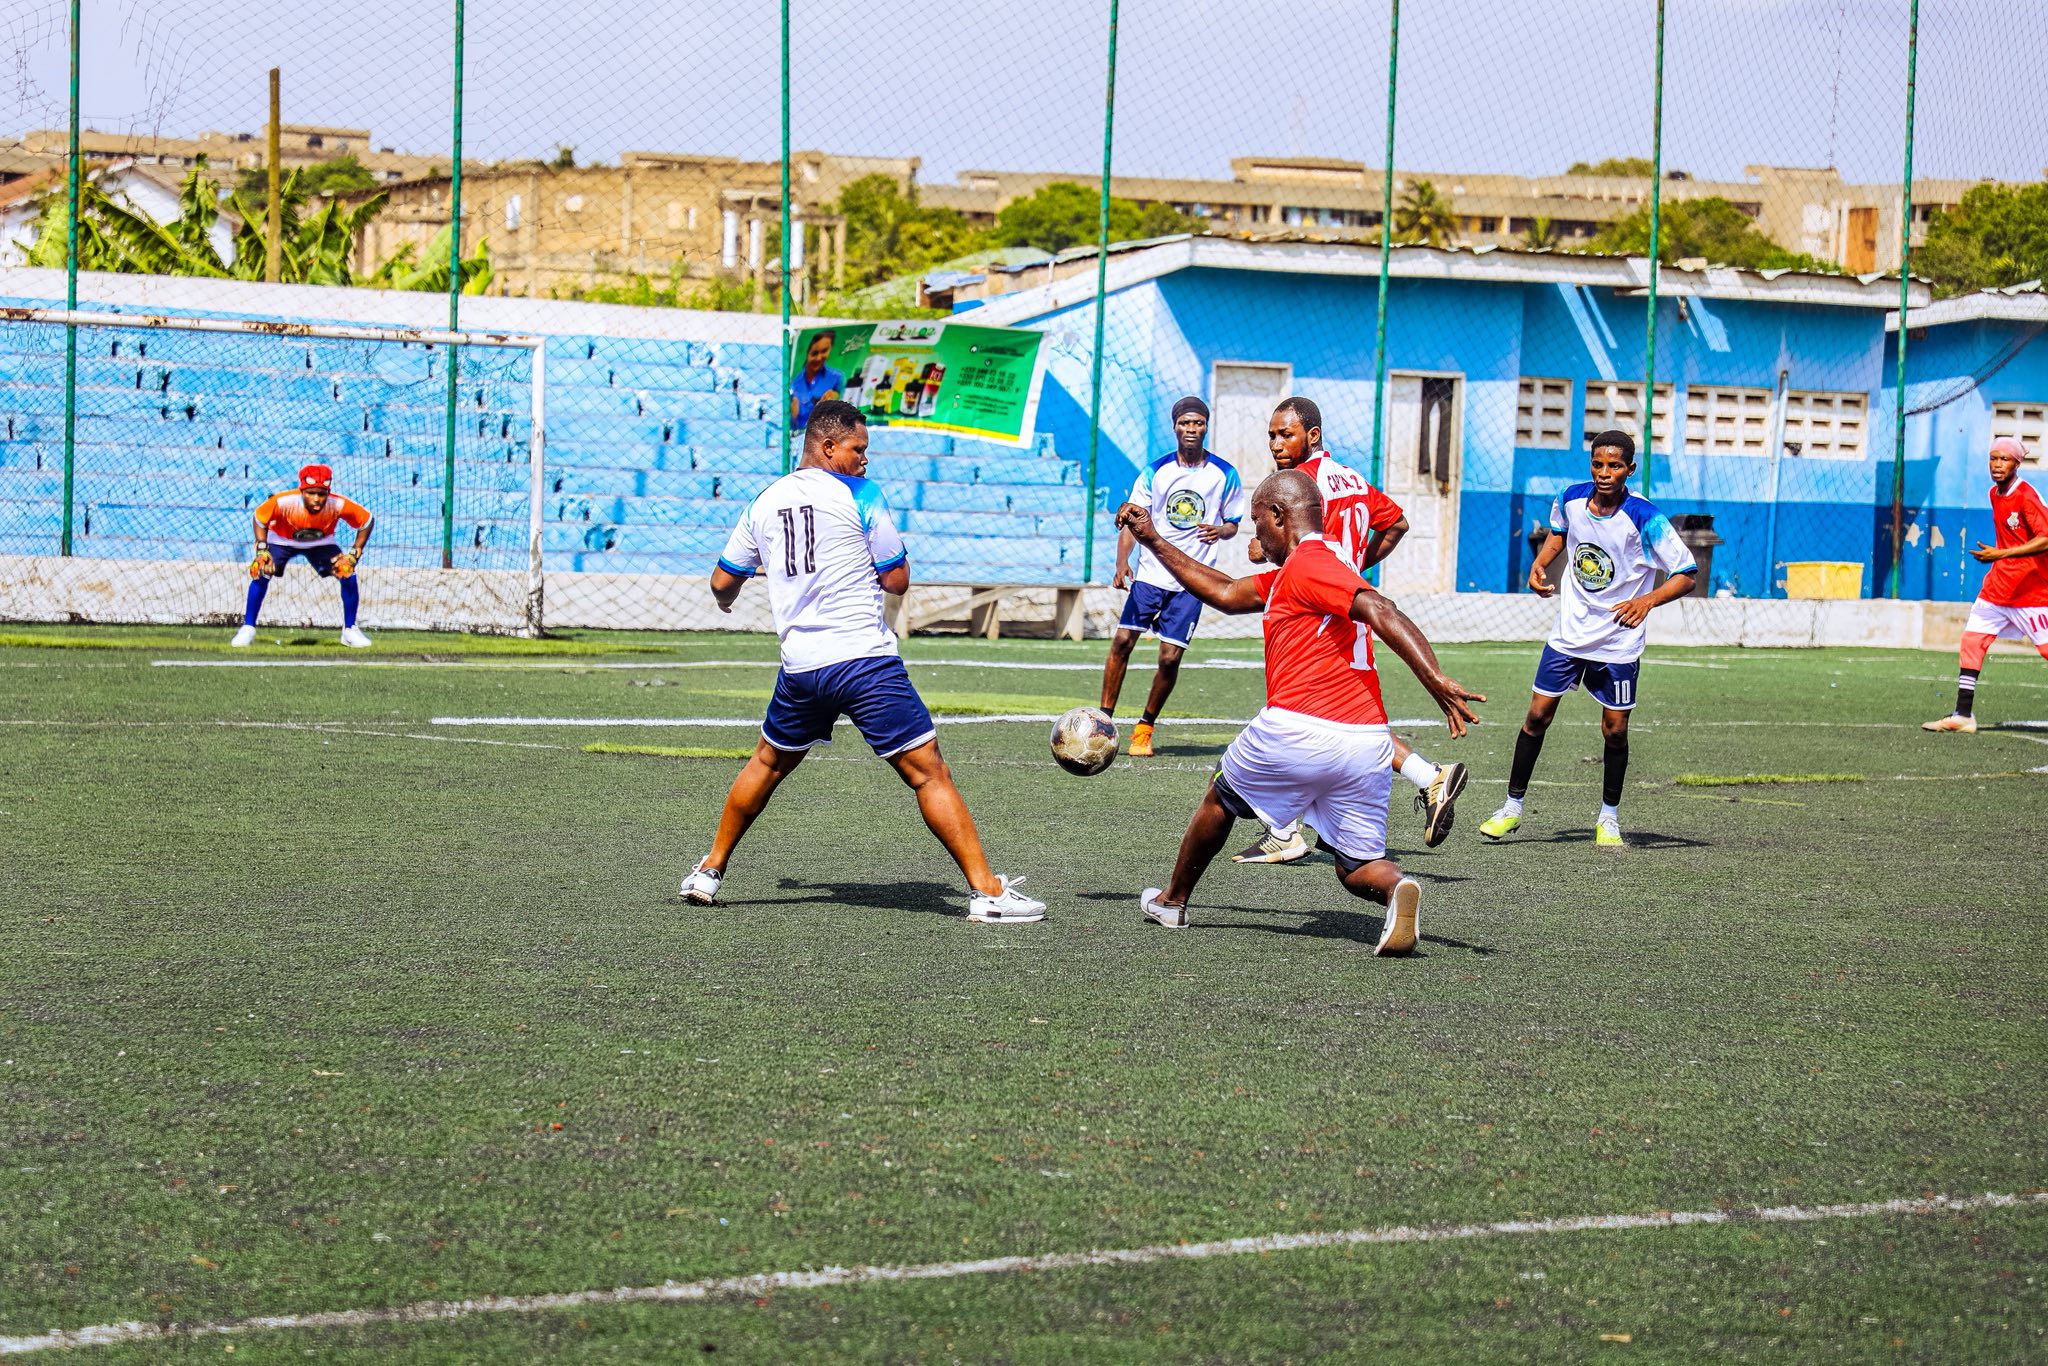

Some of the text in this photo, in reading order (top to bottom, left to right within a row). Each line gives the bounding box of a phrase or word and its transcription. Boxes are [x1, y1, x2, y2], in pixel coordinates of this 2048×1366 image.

[777, 505, 816, 578] 11
[2029, 613, 2048, 633] 10
[1613, 679, 1631, 705] 10
